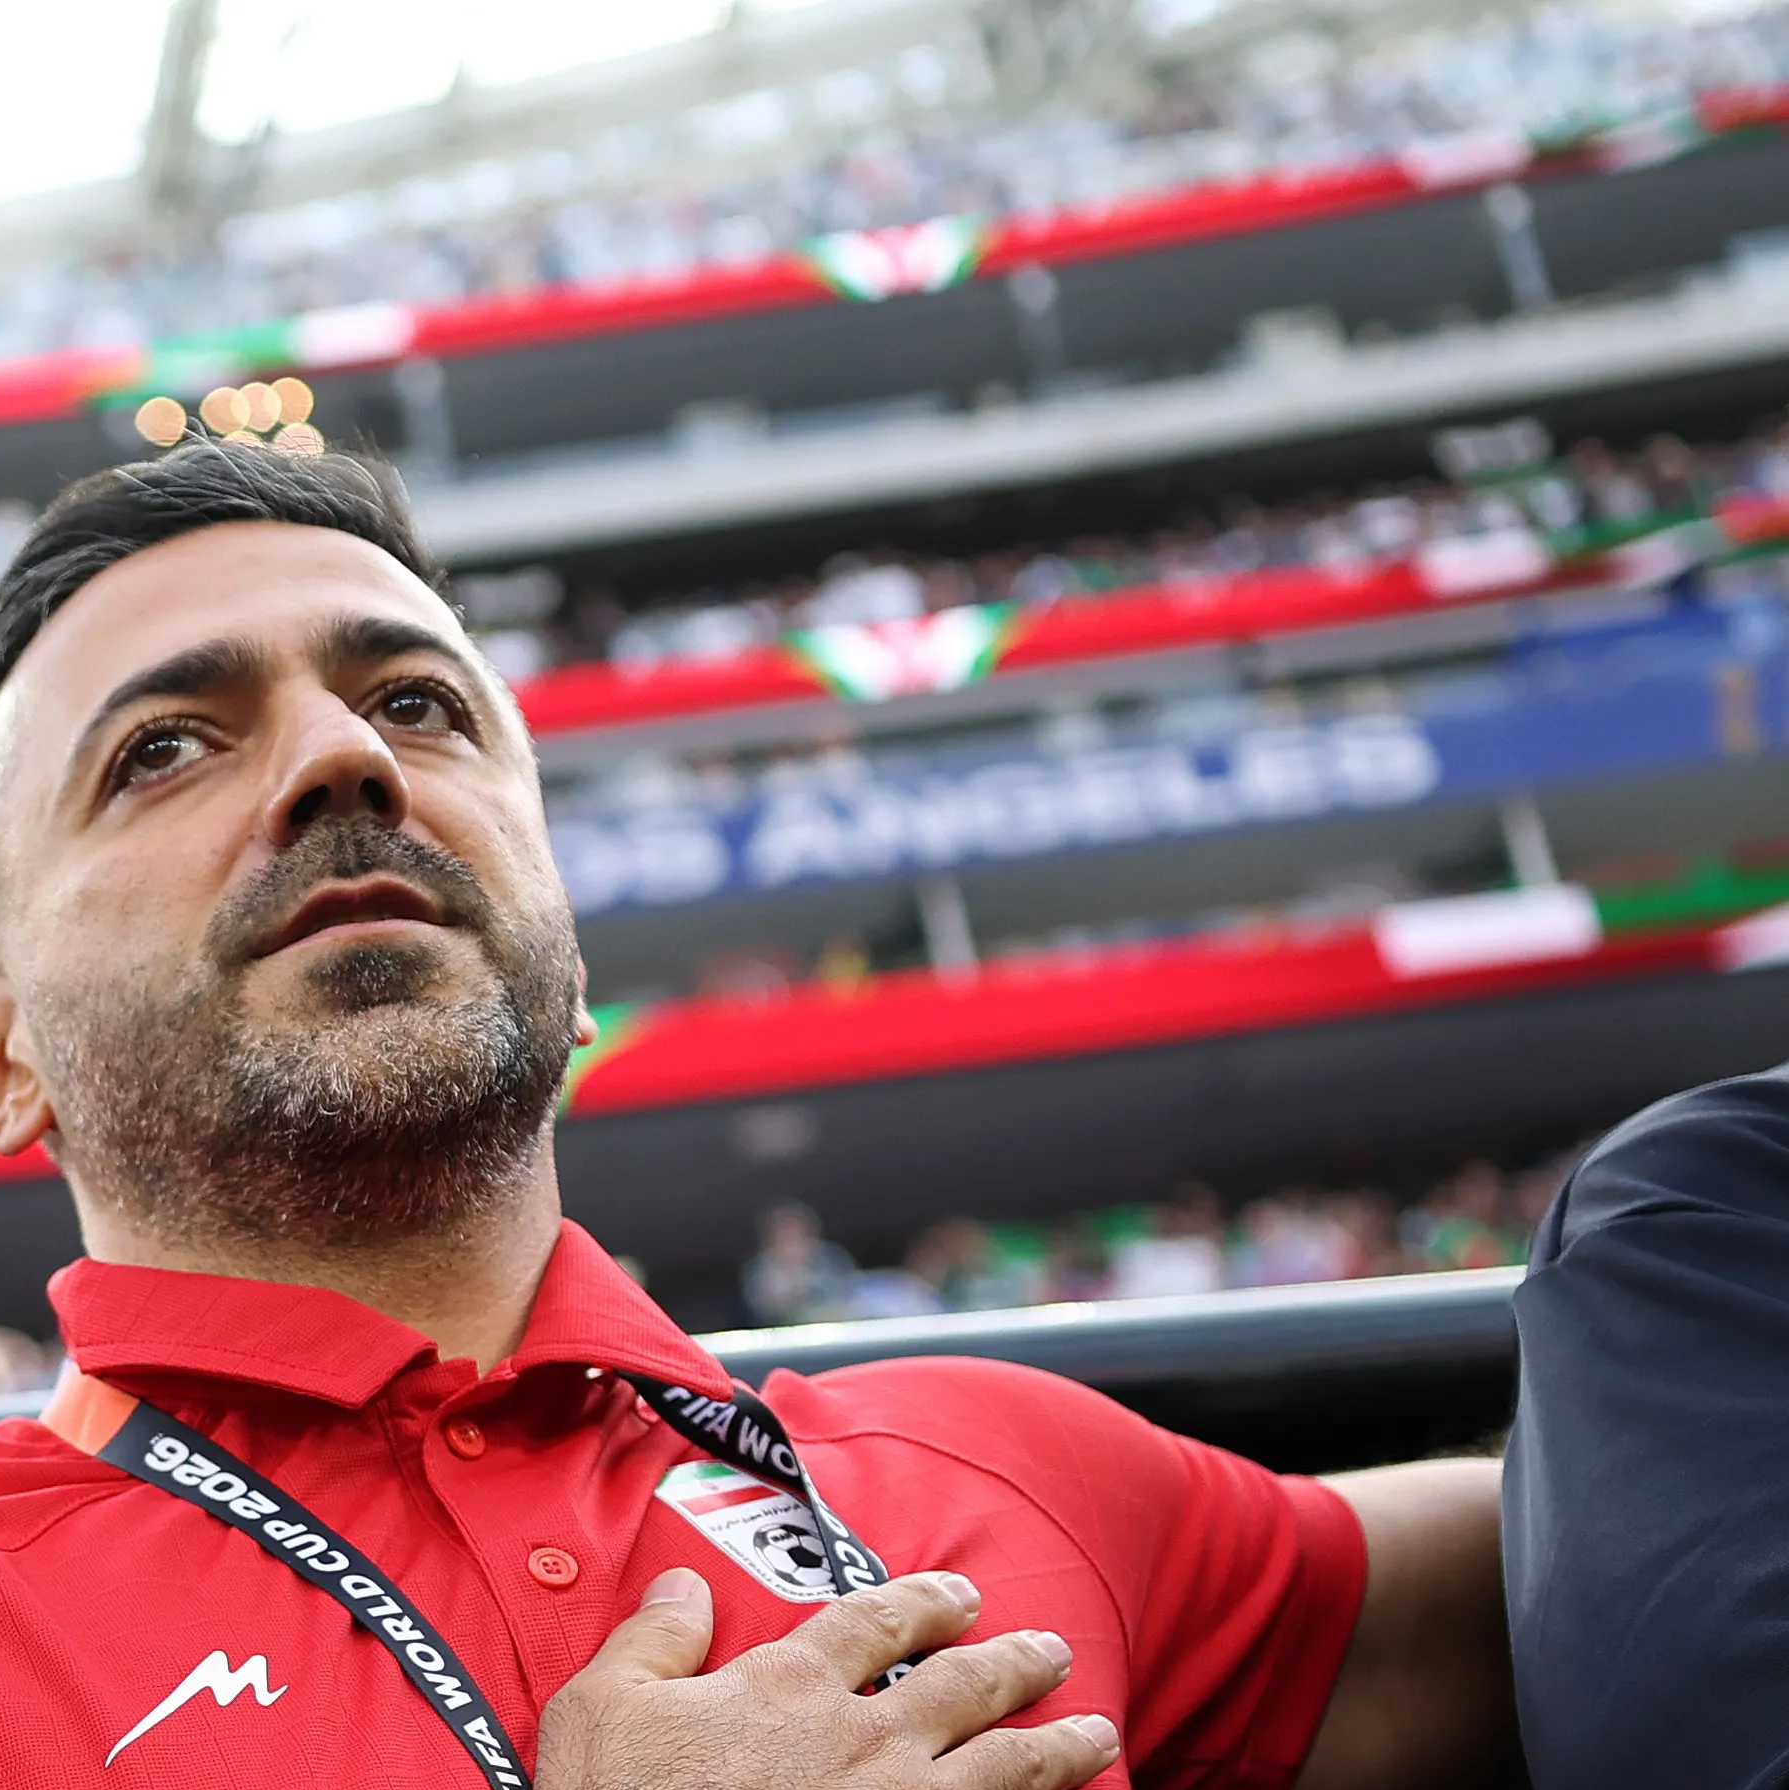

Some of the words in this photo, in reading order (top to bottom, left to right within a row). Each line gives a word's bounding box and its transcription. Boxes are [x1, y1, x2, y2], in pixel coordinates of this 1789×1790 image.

[143, 1434, 281, 1520] 2026
[263, 1518, 350, 1574] CUP
[339, 1575, 473, 1710] WORLD
